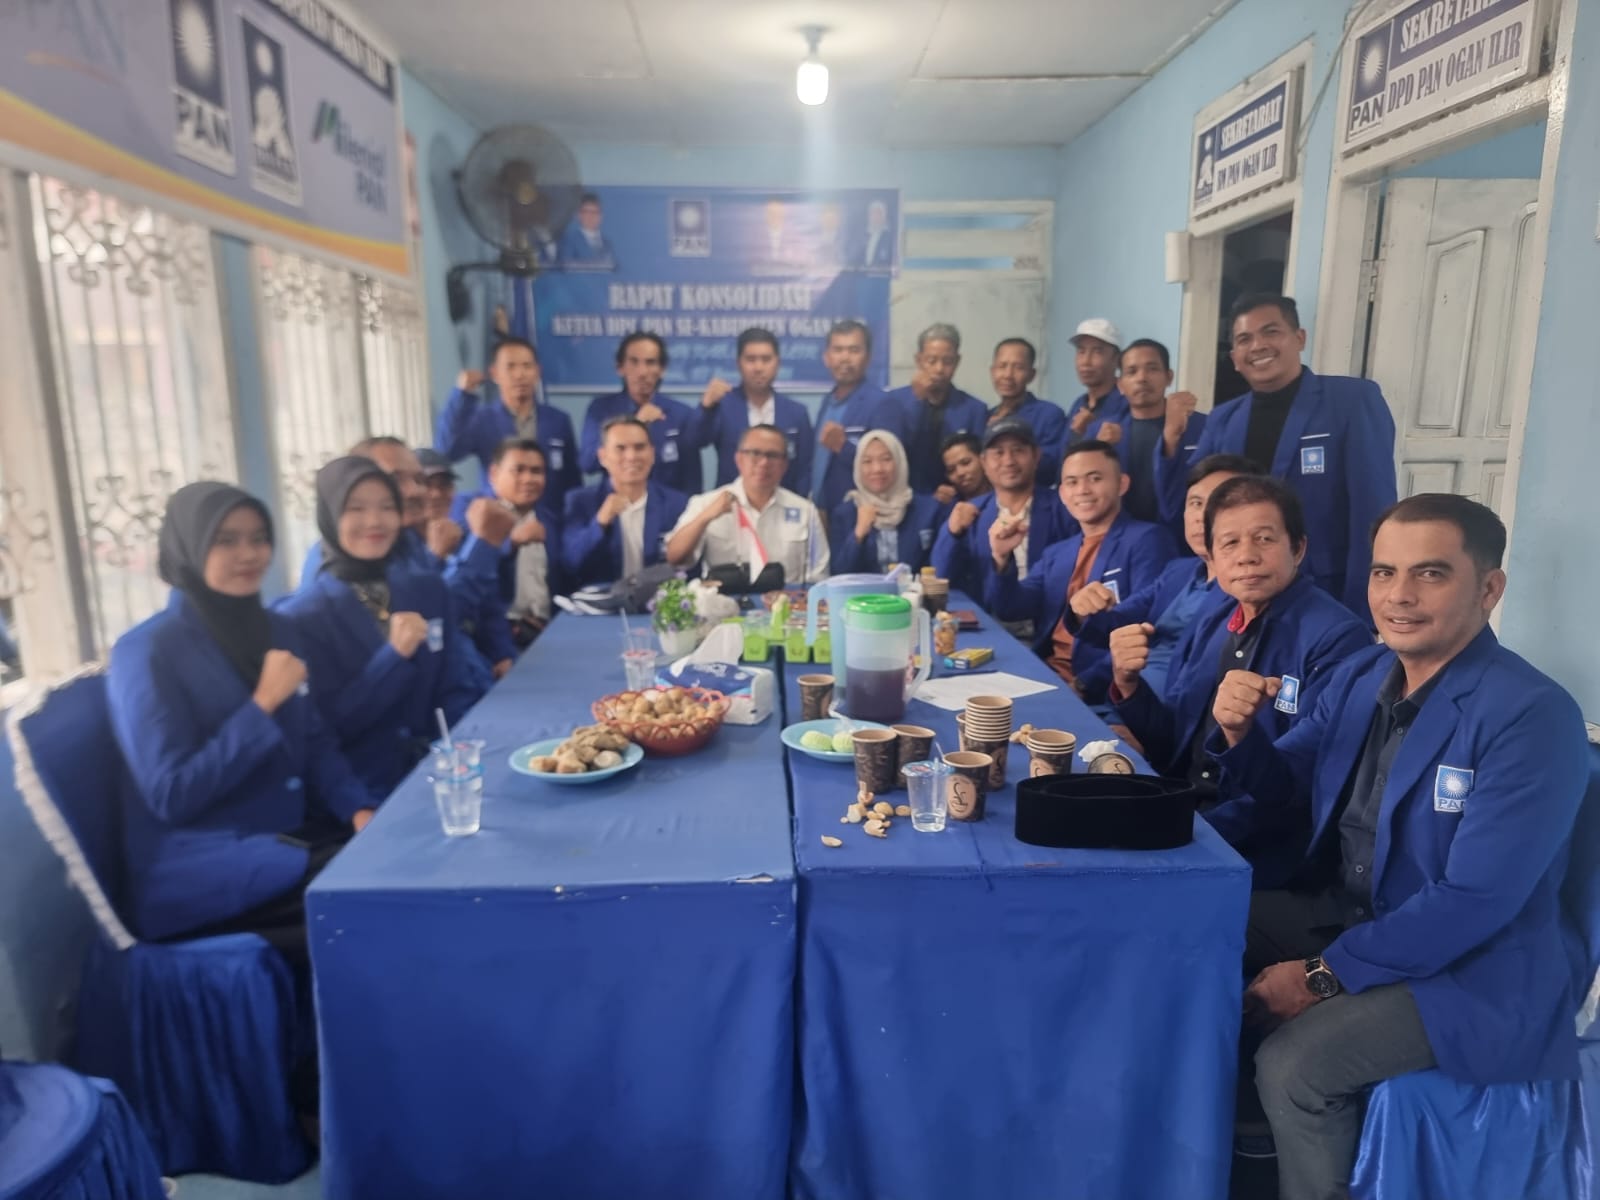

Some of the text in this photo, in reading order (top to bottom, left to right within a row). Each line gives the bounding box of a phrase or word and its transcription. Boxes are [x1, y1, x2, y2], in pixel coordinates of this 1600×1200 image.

[1387, 21, 1523, 113] DPD PAN OGAN ILIR
[177, 94, 232, 156] PAN
[1350, 94, 1385, 131] PAN
[609, 284, 812, 311] RAPAT KONSOLIDASI
